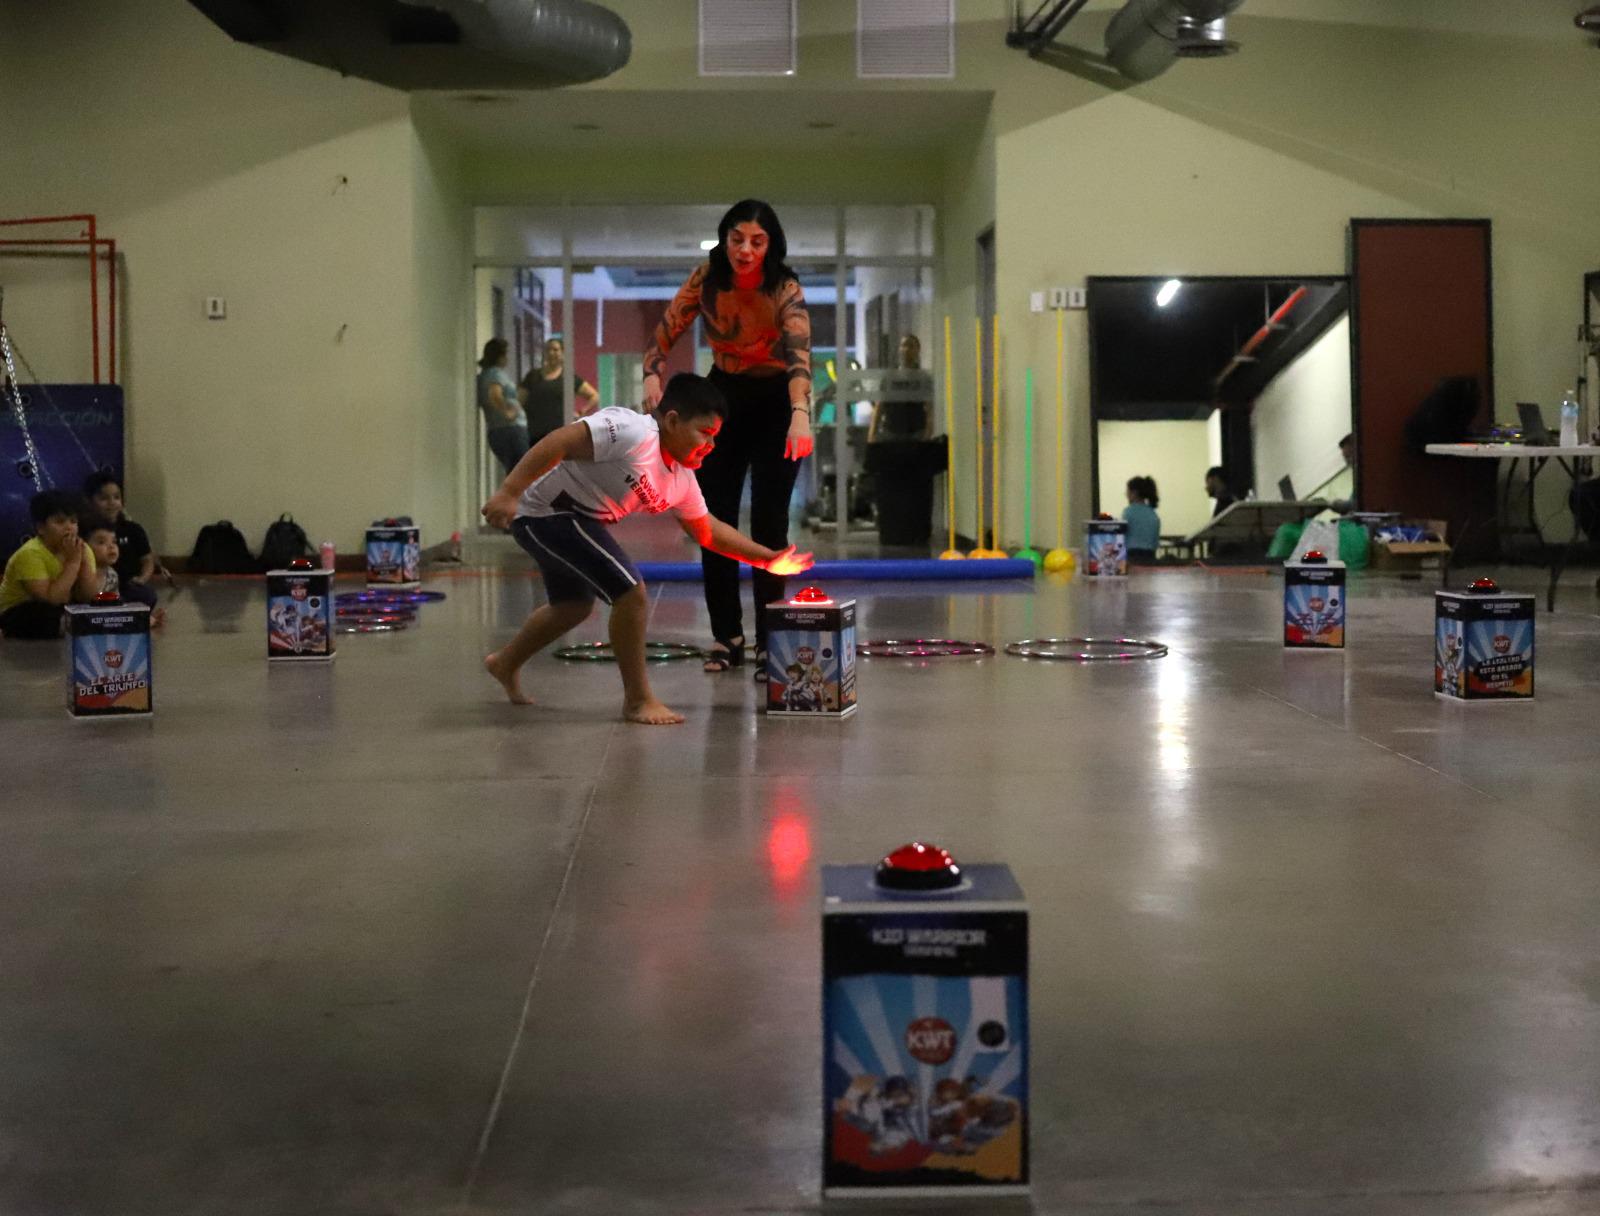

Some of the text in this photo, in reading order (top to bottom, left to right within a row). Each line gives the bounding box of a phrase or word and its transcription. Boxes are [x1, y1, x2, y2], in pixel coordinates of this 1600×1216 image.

[104, 653, 123, 663] KWT
[90, 672, 135, 687] EL ARTE
[79, 680, 146, 697] DEL TRIUNFO
[872, 929, 987, 946] KID WARRIOR
[906, 1029, 955, 1051] KWT
